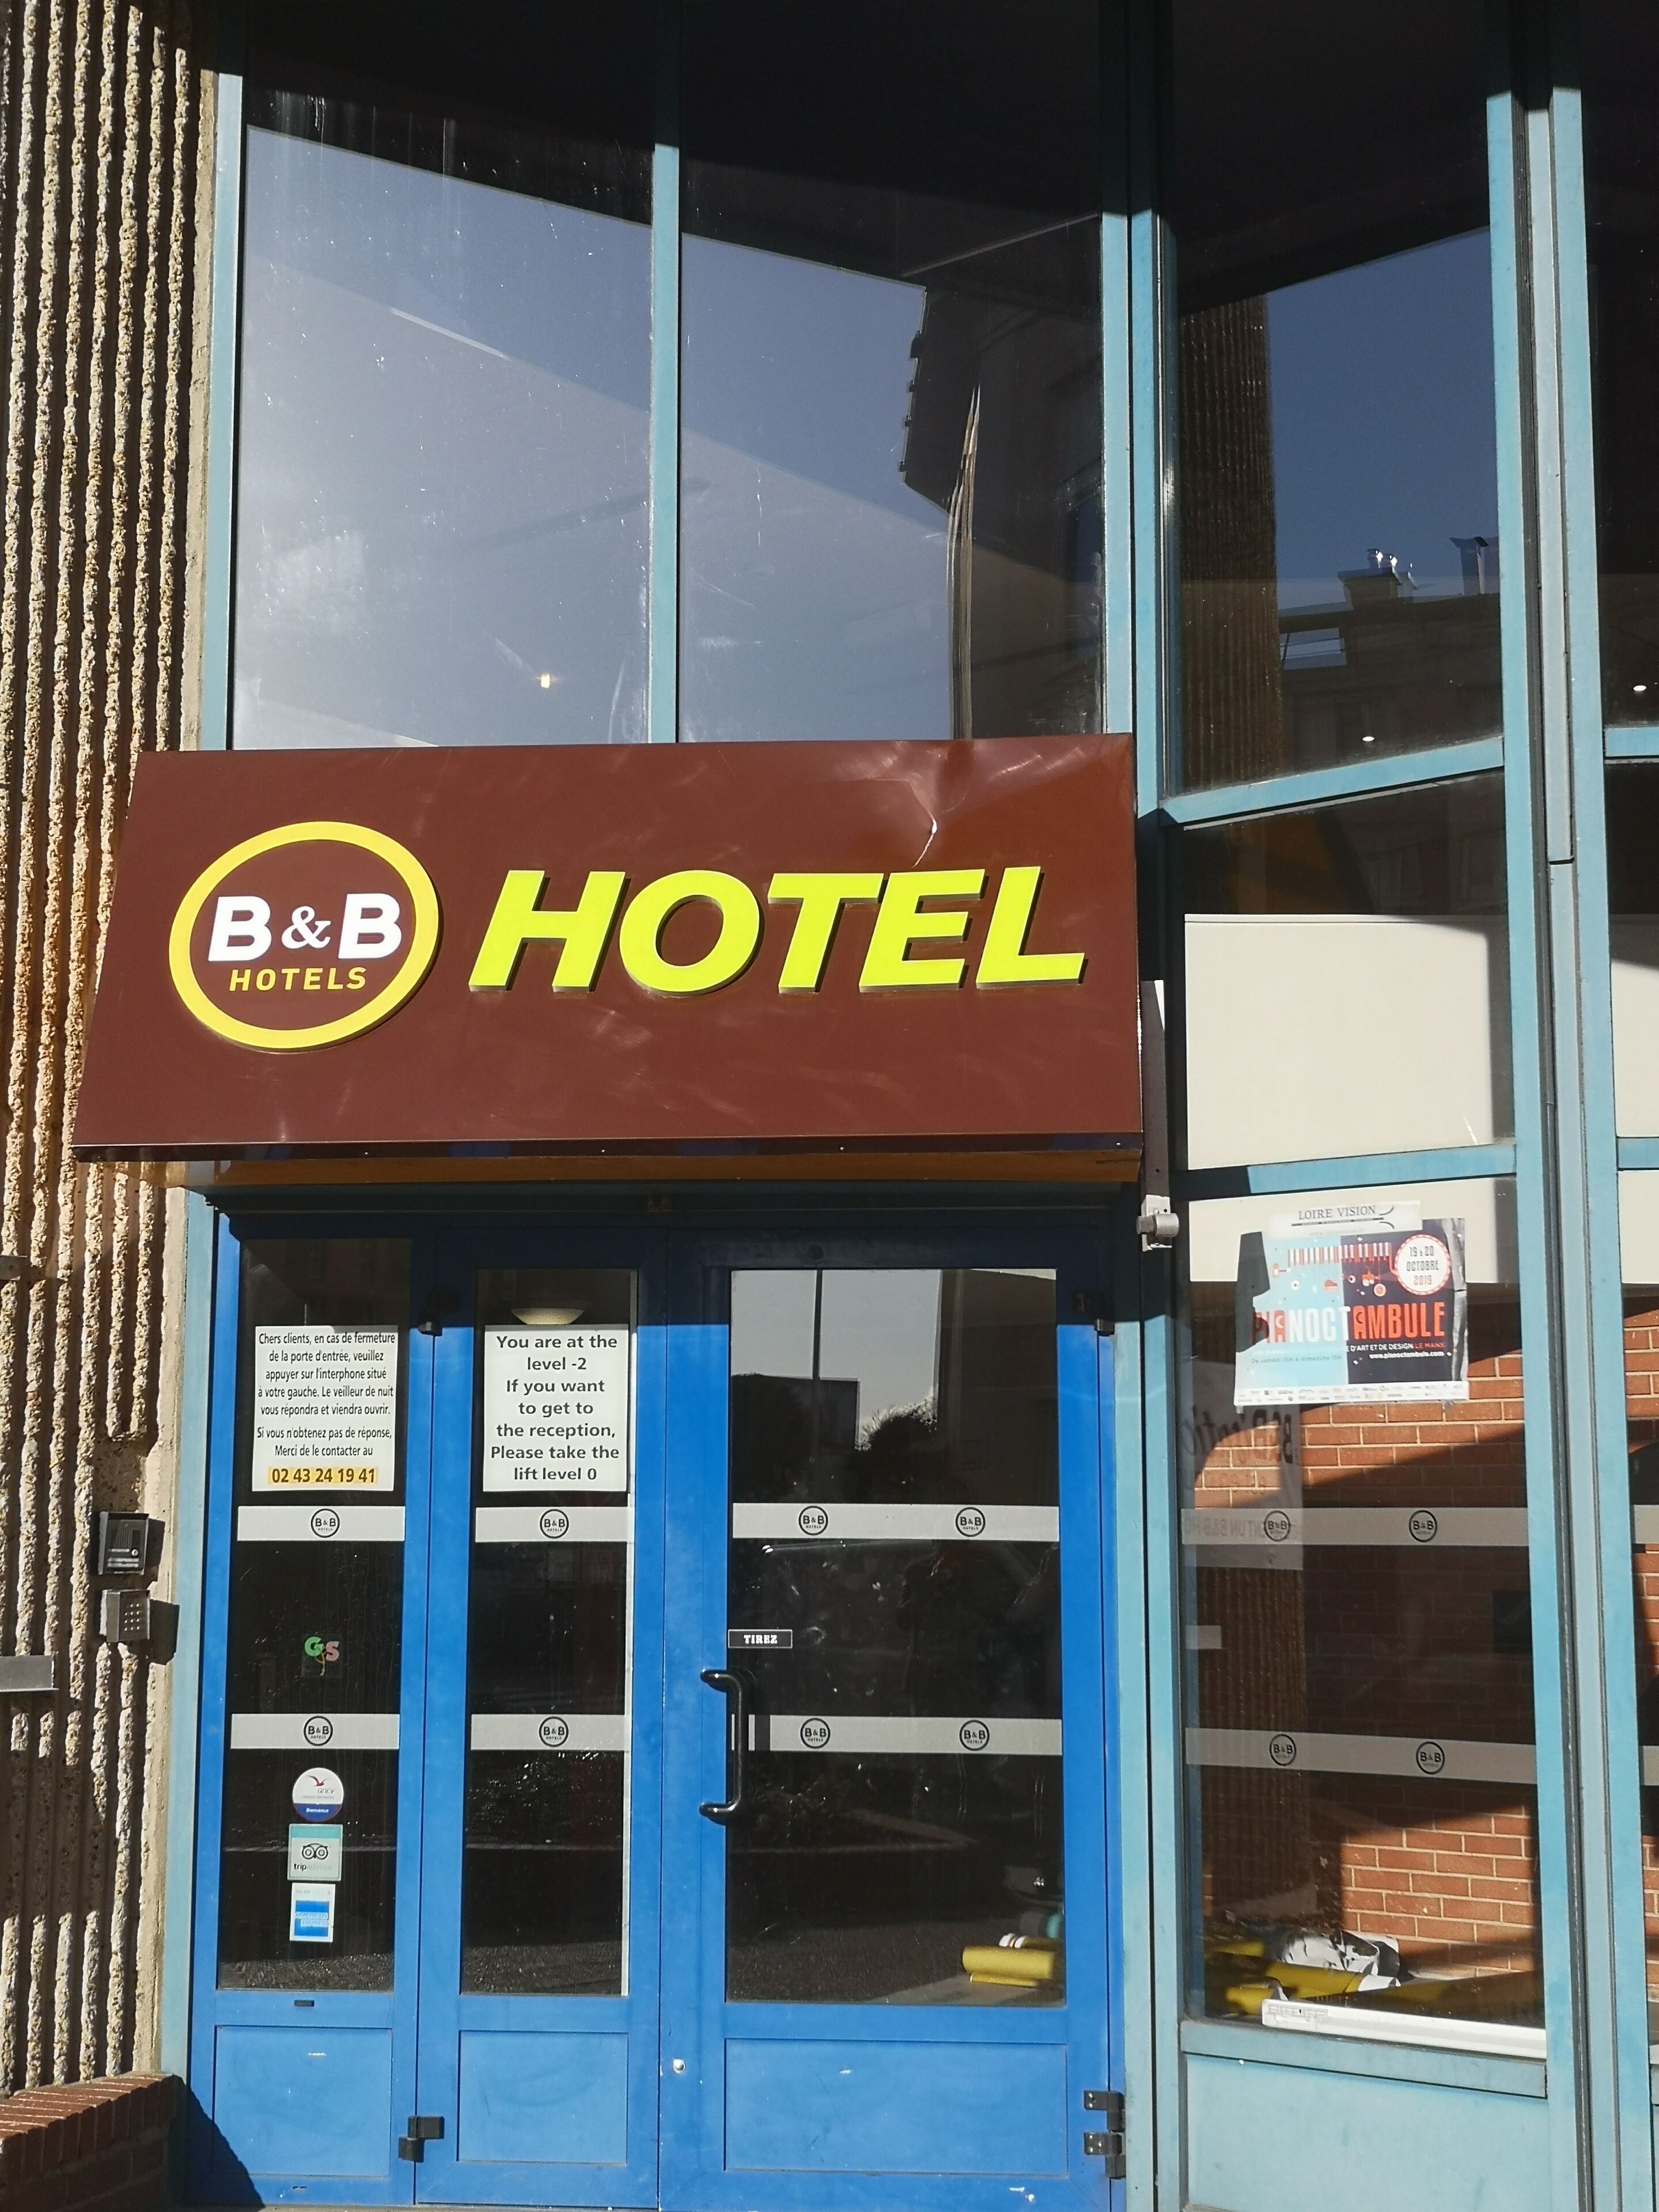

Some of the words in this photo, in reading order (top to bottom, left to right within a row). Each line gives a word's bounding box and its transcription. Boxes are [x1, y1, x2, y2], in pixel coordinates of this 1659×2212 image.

[207, 893, 402, 962] B&B
[468, 866, 1085, 995] HOTEL
[228, 967, 367, 992] HOTELS
[1298, 1209, 1333, 1220] LOIRE
[1336, 1205, 1376, 1217] VISION
[1409, 1247, 1418, 1257] 19
[1424, 1245, 1434, 1256] 20
[1406, 1260, 1440, 1271] OCTOBRE
[1414, 1275, 1432, 1285] 2019
[1252, 1301, 1446, 1345] PIANOCTAMBULE
[259, 1332, 281, 1344] Chers
[283, 1332, 312, 1345] clients,
[314, 1335, 324, 1344] en
[327, 1335, 340, 1344] cas
[342, 1332, 353, 1344] de
[354, 1332, 396, 1344] fermeture
[496, 1336, 529, 1349] You
[535, 1338, 562, 1349] are
[567, 1336, 584, 1348] at
[589, 1334, 618, 1348] the
[1388, 1342, 1414, 1351] DESIGN
[269, 1350, 279, 1362] de
[281, 1350, 289, 1362] la
[290, 1351, 313, 1363] porte
[315, 1350, 351, 1362] d'entrée,
[353, 1349, 384, 1361] veuillez
[527, 1357, 566, 1370] level
[571, 1357, 586, 1370] -2
[266, 1370, 299, 1382] appuyer
[301, 1370, 314, 1380] sur
[316, 1367, 365, 1382] l'interphone
[367, 1367, 387, 1379] situé
[258, 1388, 263, 1397] à
[264, 1387, 285, 1397] votre
[287, 1385, 319, 1400] gauche.
[321, 1386, 331, 1397] Le
[333, 1385, 363, 1397] veilleur
[365, 1385, 376, 1397] de
[377, 1385, 393, 1397] nuit
[506, 1378, 518, 1392] If
[524, 1382, 555, 1396] you
[561, 1380, 605, 1392] want
[260, 1406, 279, 1415] vous
[281, 1403, 319, 1418] répondra
[321, 1404, 329, 1415] et
[331, 1403, 362, 1415] viendra
[364, 1403, 390, 1415] ouvrir.
[518, 1402, 536, 1414] to
[541, 1402, 570, 1418] get
[575, 1402, 593, 1414] to
[257, 1426, 264, 1438] Si
[266, 1430, 285, 1438] vous
[286, 1426, 327, 1438] n'obtenez
[328, 1429, 343, 1441] pas
[345, 1426, 355, 1438] de
[358, 1426, 392, 1441] réponse,
[496, 1423, 524, 1437] the
[529, 1423, 615, 1440] reception,
[275, 1444, 297, 1456] Merci
[300, 1444, 310, 1456] de
[312, 1444, 319, 1456] le
[321, 1446, 361, 1456] contacter
[363, 1447, 373, 1456] au
[491, 1445, 544, 1459] Please
[548, 1445, 586, 1459] take
[591, 1445, 619, 1459] the
[272, 1468, 289, 1483] 02
[293, 1468, 310, 1483] 43
[315, 1468, 333, 1483] 24
[338, 1468, 354, 1483] 19
[358, 1468, 374, 1483] 41
[514, 1467, 538, 1480] lift
[543, 1467, 581, 1480] level
[587, 1468, 597, 1480] 0
[315, 1518, 336, 1528] B&B
[544, 1518, 566, 1528] B&B
[802, 1515, 824, 1525] B&B
[960, 1517, 982, 1527] B&B
[743, 1634, 778, 1645] TIREZ
[308, 1726, 329, 1735] B&B
[543, 1726, 565, 1736] B&B
[805, 1728, 827, 1738] B&B
[964, 1730, 986, 1740] B&B
